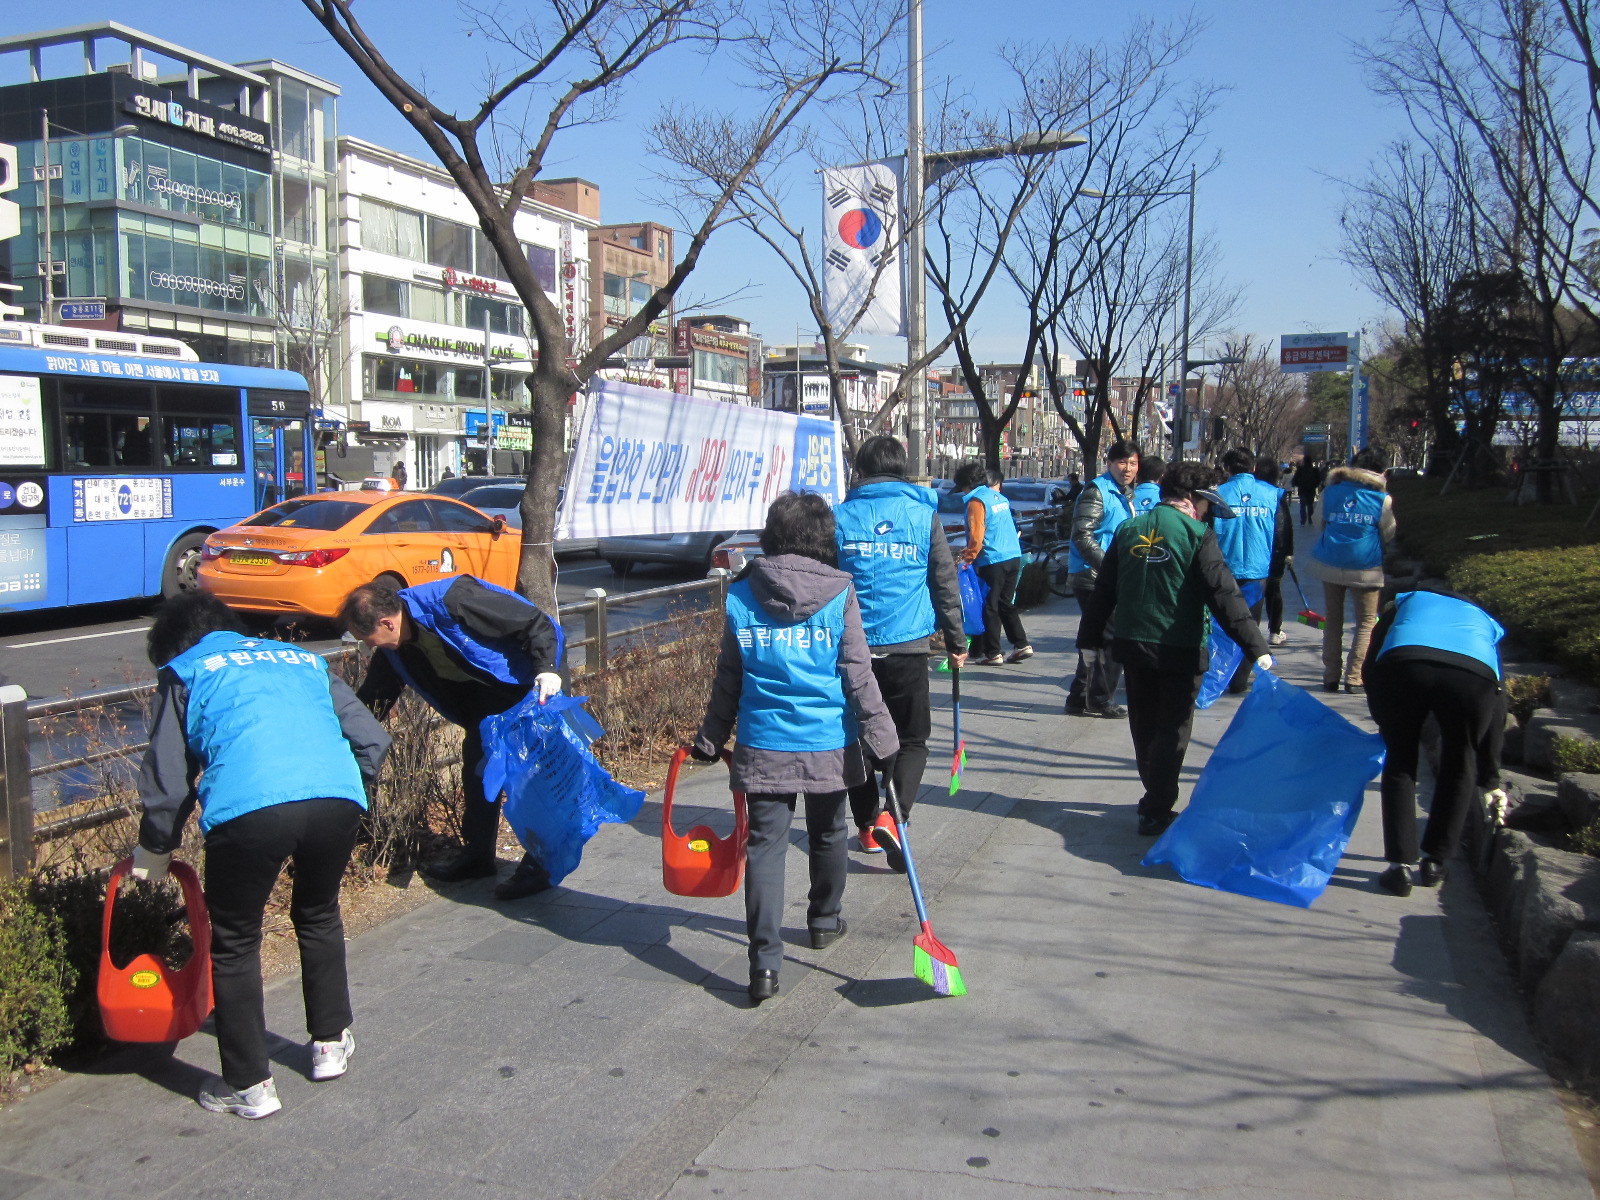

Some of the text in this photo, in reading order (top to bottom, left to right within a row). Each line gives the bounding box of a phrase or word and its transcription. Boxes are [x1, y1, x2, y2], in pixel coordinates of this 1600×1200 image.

[135, 95, 167, 122] 연세
[185, 110, 216, 138] 치과
[71, 160, 80, 195] 연세
[97, 158, 107, 192] 치과
[565, 283, 574, 337] 노래연습장
[408, 333, 452, 349] CHARLIE
[491, 343, 515, 359] CAFÉ
[1285, 350, 1330, 362] 응급의료센터
[46, 356, 78, 371] 맑아진
[80, 359, 100, 374] 서울
[125, 364, 144, 378] 이젠
[146, 365, 181, 380] 서울에서
[182, 367, 200, 381] 별을
[382, 414, 402, 429] ROA
[511, 417, 522, 426] New
[23, 486, 37, 495] 건대
[220, 478, 245, 487] 서부운수
[21, 494, 40, 503] 입구역
[74, 480, 84, 517] 북가좌동
[118, 493, 132, 506] 721
[1232, 507, 1269, 517] 린지킴이
[9, 549, 34, 562] 넘다!
[737, 626, 833, 648] 클린지킴이
[203, 650, 317, 672] 클린지킴이
